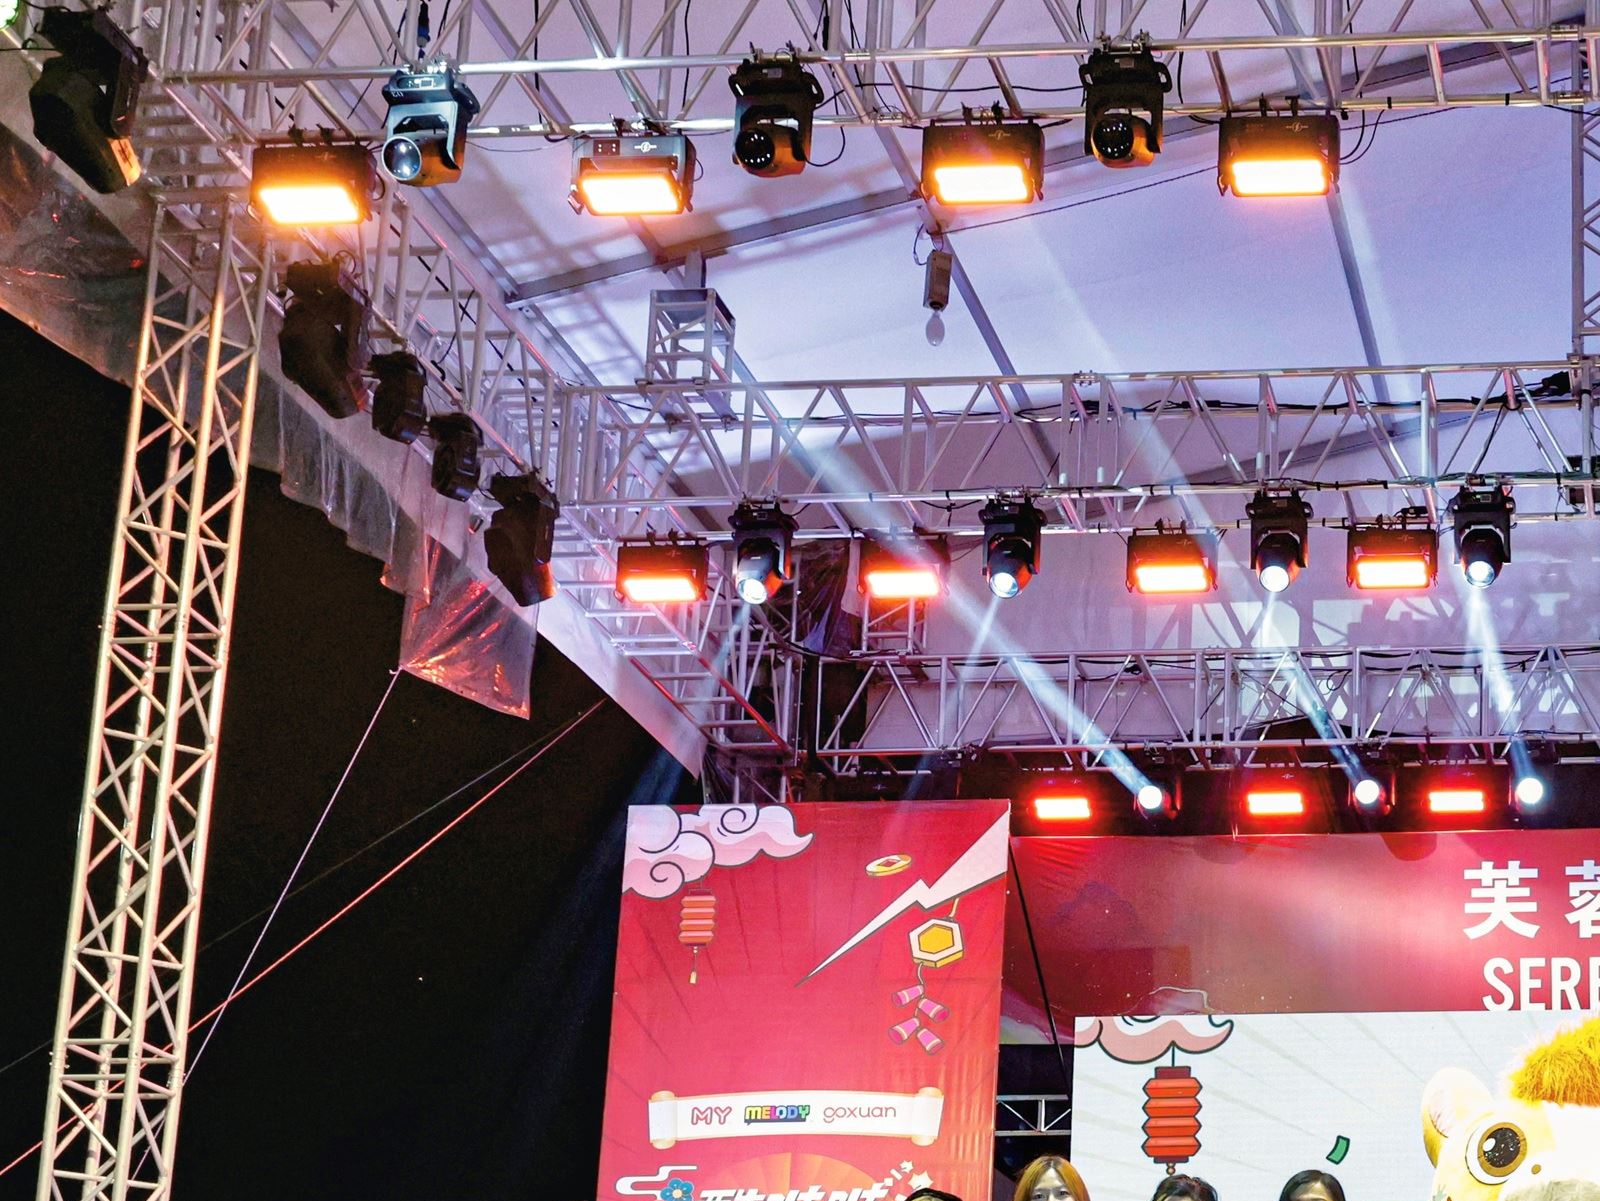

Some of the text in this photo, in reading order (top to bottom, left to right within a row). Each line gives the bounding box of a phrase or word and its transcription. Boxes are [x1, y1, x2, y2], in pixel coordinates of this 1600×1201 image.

[691, 1104, 897, 1126] MY MELODY goxuan
